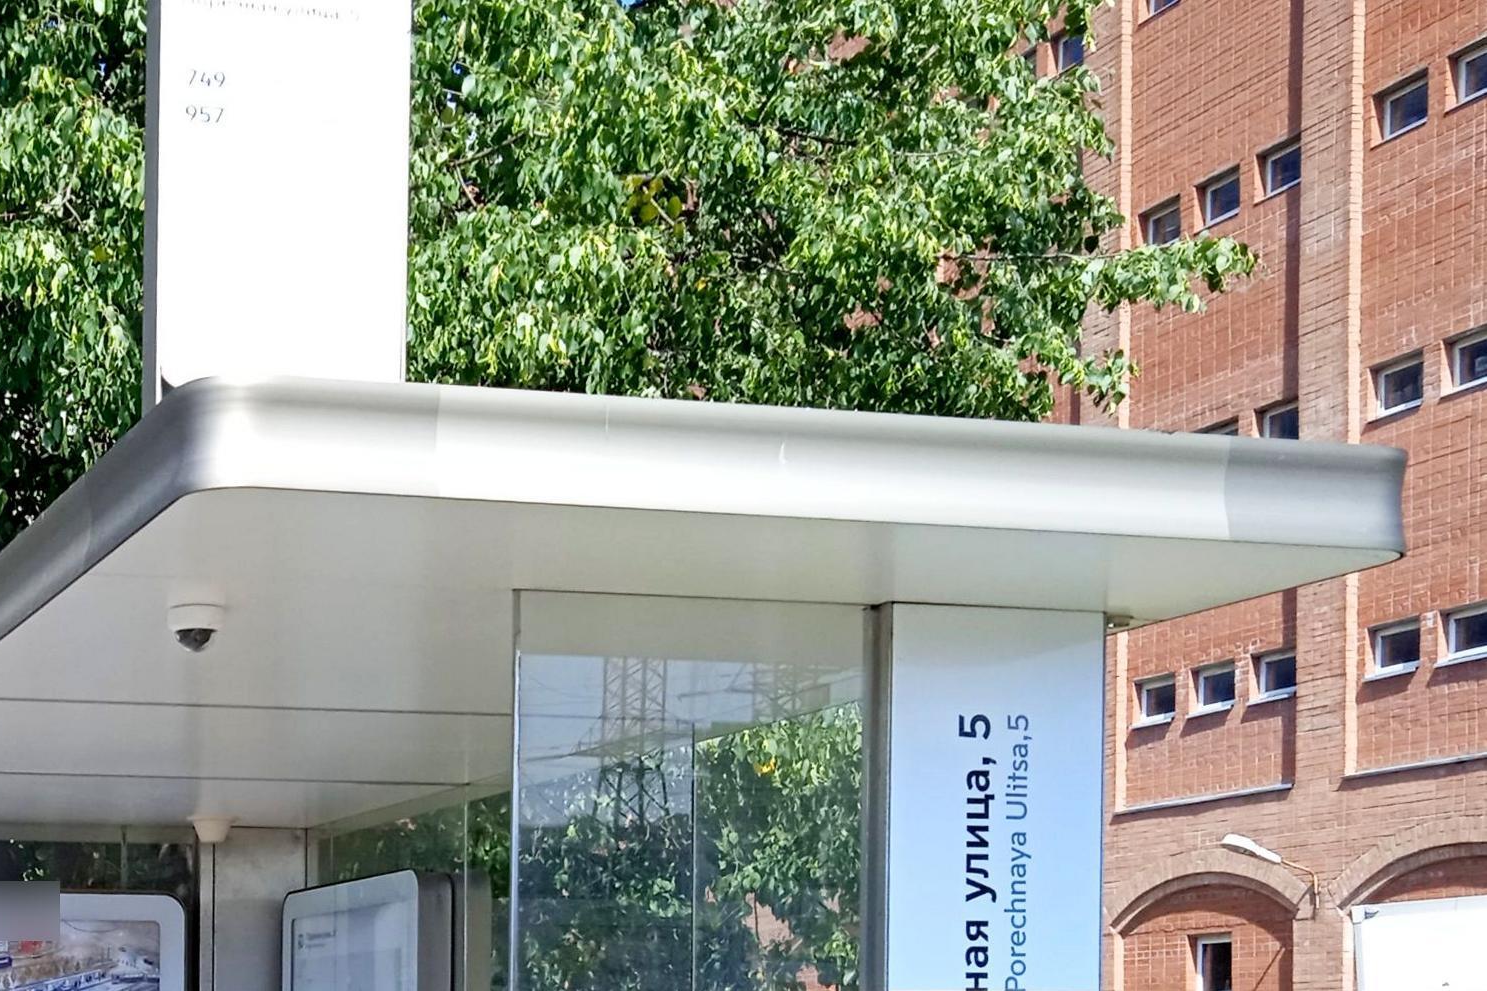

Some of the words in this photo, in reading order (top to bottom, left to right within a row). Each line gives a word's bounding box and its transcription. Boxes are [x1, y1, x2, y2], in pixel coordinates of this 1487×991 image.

[188, 68, 226, 88] 749
[185, 105, 225, 124] 957
[958, 713, 992, 741] 5
[964, 756, 997, 904] улица,
